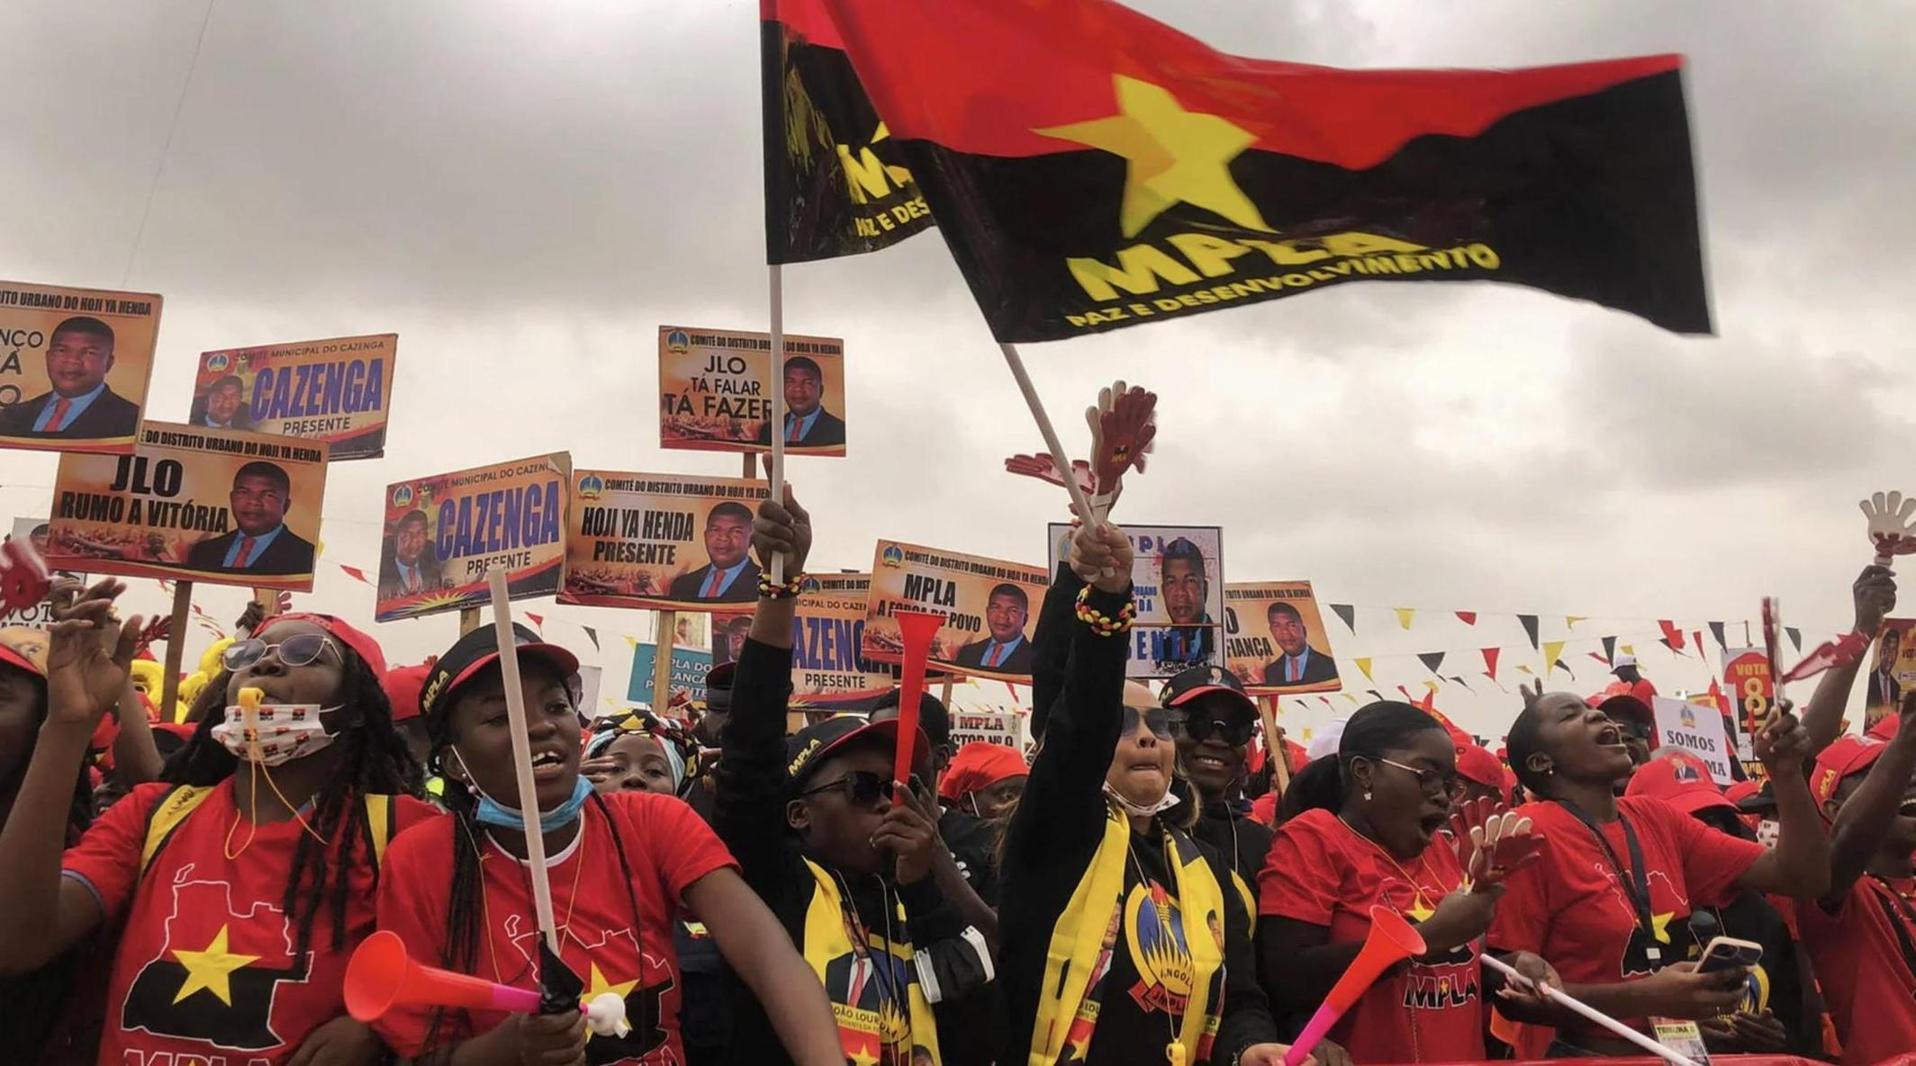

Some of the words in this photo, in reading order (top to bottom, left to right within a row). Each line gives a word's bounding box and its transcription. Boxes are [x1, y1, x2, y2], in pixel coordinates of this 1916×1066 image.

[1066, 231, 1436, 301] MPLA
[1065, 304, 1130, 329] PAZ
[1134, 300, 1155, 317] E
[1152, 242, 1501, 313] DESENVOLVIMENTO
[20, 293, 62, 309] URBANO
[63, 296, 79, 310] DO
[0, 347, 22, 375] Á
[704, 355, 746, 375] JLO
[252, 358, 383, 423] CAZENGA
[690, 372, 709, 393] TÁ
[713, 379, 761, 396] FALAR
[664, 387, 695, 416] TÁ
[282, 416, 351, 435] PRESENTE
[144, 430, 159, 443] DO
[160, 431, 204, 449] DISTRITO
[205, 434, 244, 454] URBANO
[244, 439, 258, 455] DO
[109, 454, 183, 497] JLO
[516, 463, 549, 476] CAZEN
[61, 491, 123, 523] RUMO
[127, 499, 142, 525] A
[147, 499, 229, 533] VITÓRIA
[434, 480, 560, 562] CAZENGA
[581, 506, 618, 537] HOJI
[620, 508, 641, 540] YA
[642, 510, 695, 542] HENDA
[593, 541, 676, 565] PRESENTE
[904, 573, 956, 607] MPLA
[7, 604, 60, 622] VOT
[949, 612, 981, 633] POVO
[805, 673, 866, 689] PRESENTE
[1744, 677, 1767, 716] 8
[960, 716, 1004, 731] MPLA
[1666, 730, 1716, 752] SOMOS
[787, 738, 823, 777] MPLA
[1403, 968, 1478, 1009] MPLA
[834, 1005, 854, 1018] OÃO
